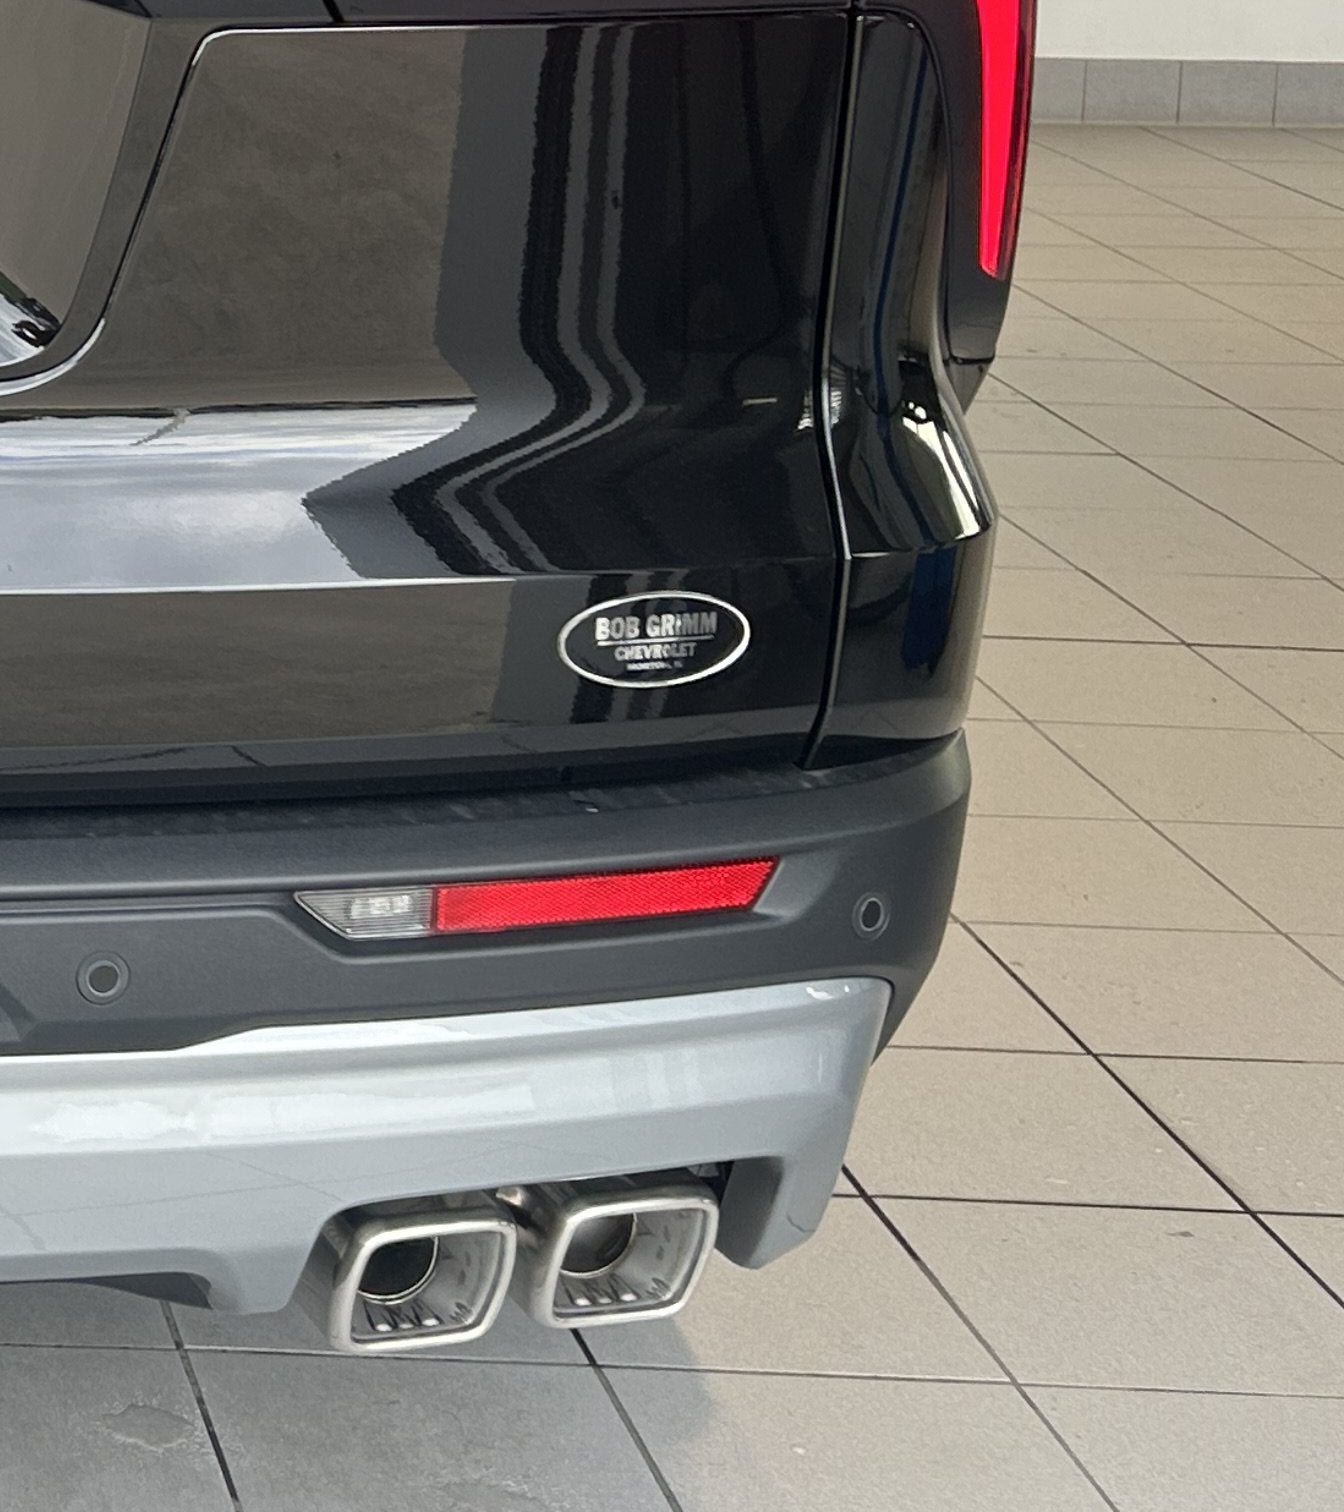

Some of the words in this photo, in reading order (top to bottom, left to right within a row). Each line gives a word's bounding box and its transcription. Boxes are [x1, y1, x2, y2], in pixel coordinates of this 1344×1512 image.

[595, 616, 641, 641] BOB
[645, 611, 718, 638] GRIMM
[614, 642, 698, 662] CHEVROLET
